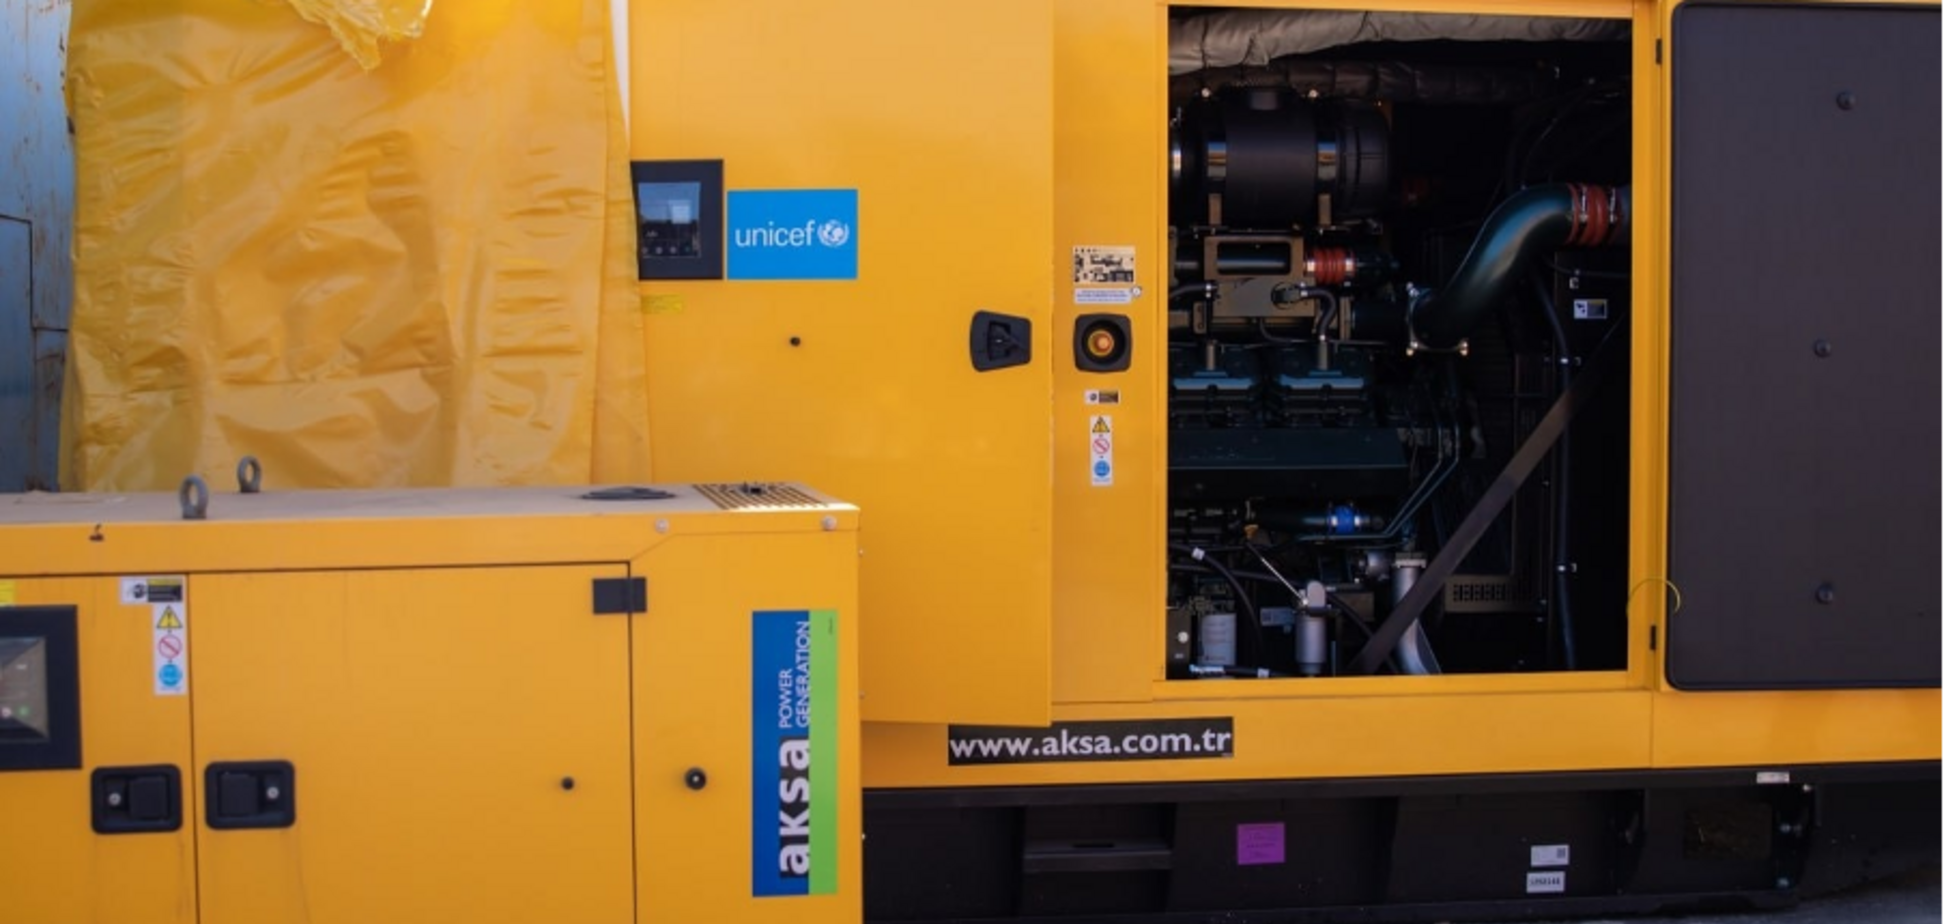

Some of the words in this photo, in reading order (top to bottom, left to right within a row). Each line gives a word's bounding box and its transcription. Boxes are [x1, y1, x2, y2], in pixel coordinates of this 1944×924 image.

[735, 220, 816, 247] unicef
[779, 668, 793, 729] POWER
[795, 621, 811, 729] GENERATION
[949, 728, 1232, 758] www.aksa.com.tr
[779, 738, 811, 875] aksa
